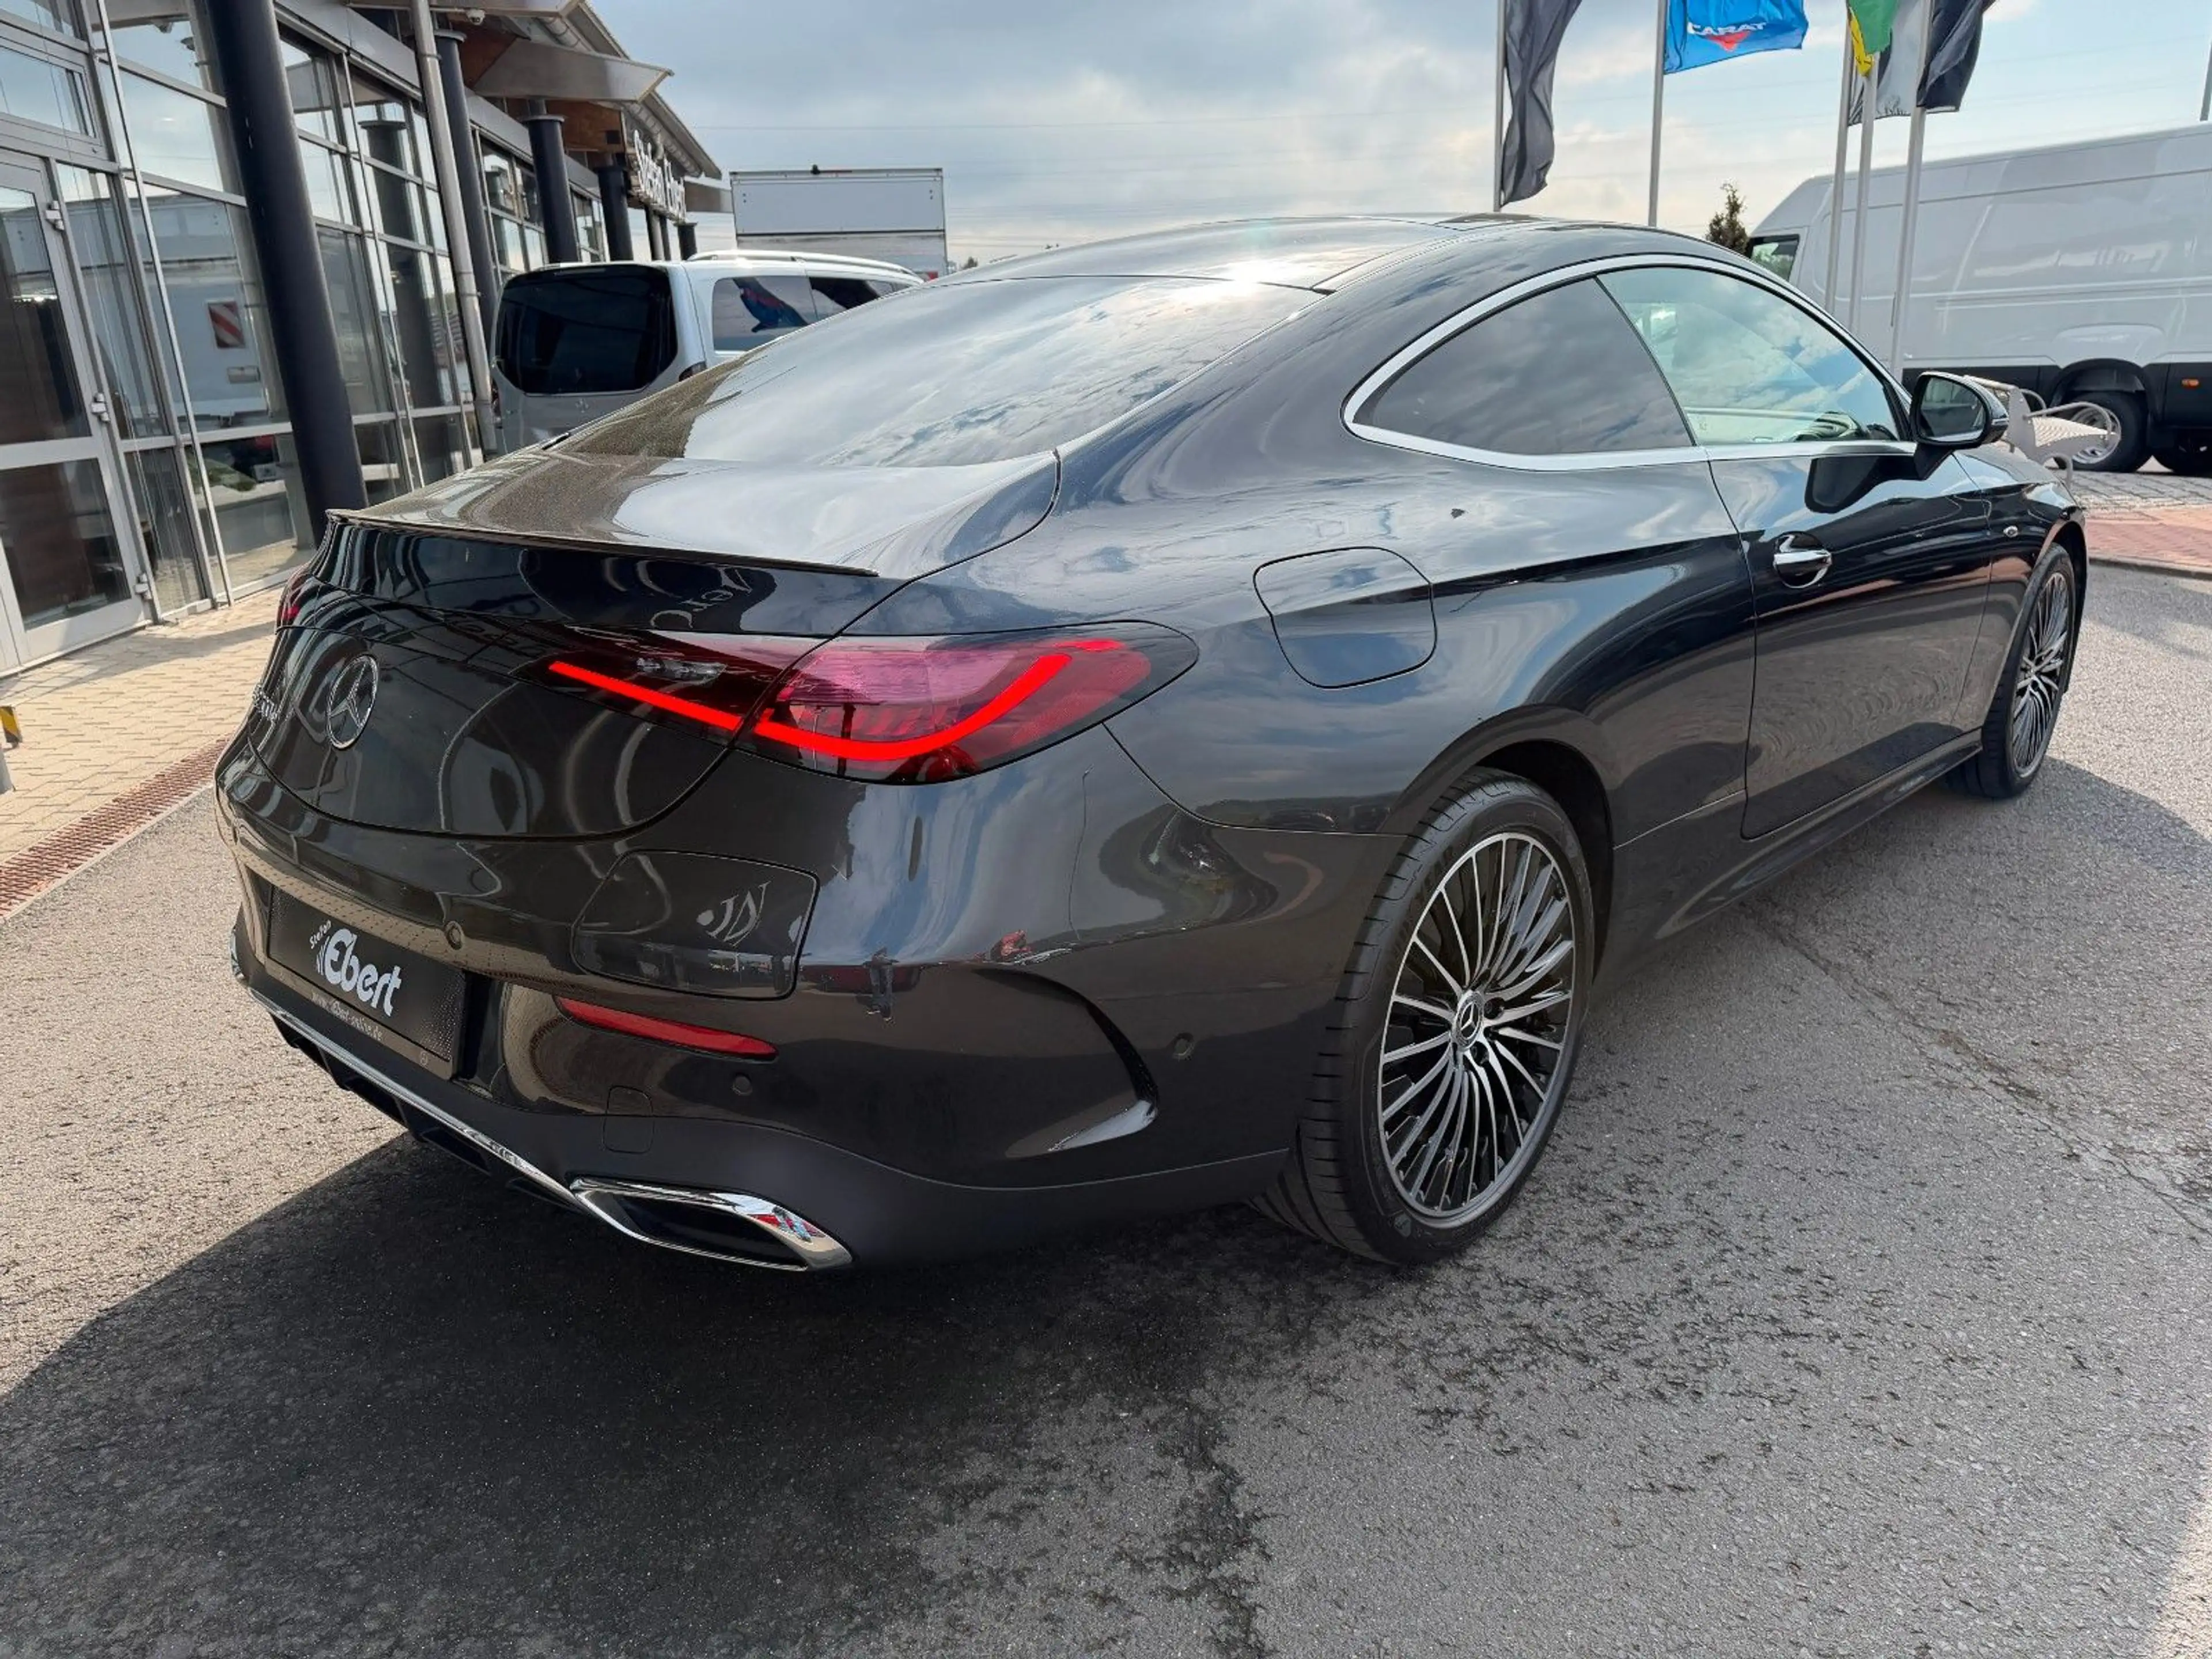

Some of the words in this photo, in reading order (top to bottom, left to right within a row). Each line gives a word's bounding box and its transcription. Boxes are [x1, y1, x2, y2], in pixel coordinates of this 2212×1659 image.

[1687, 22, 1766, 35] CARAT
[309, 920, 331, 949] Stefan
[325, 928, 402, 1017] Ebert
